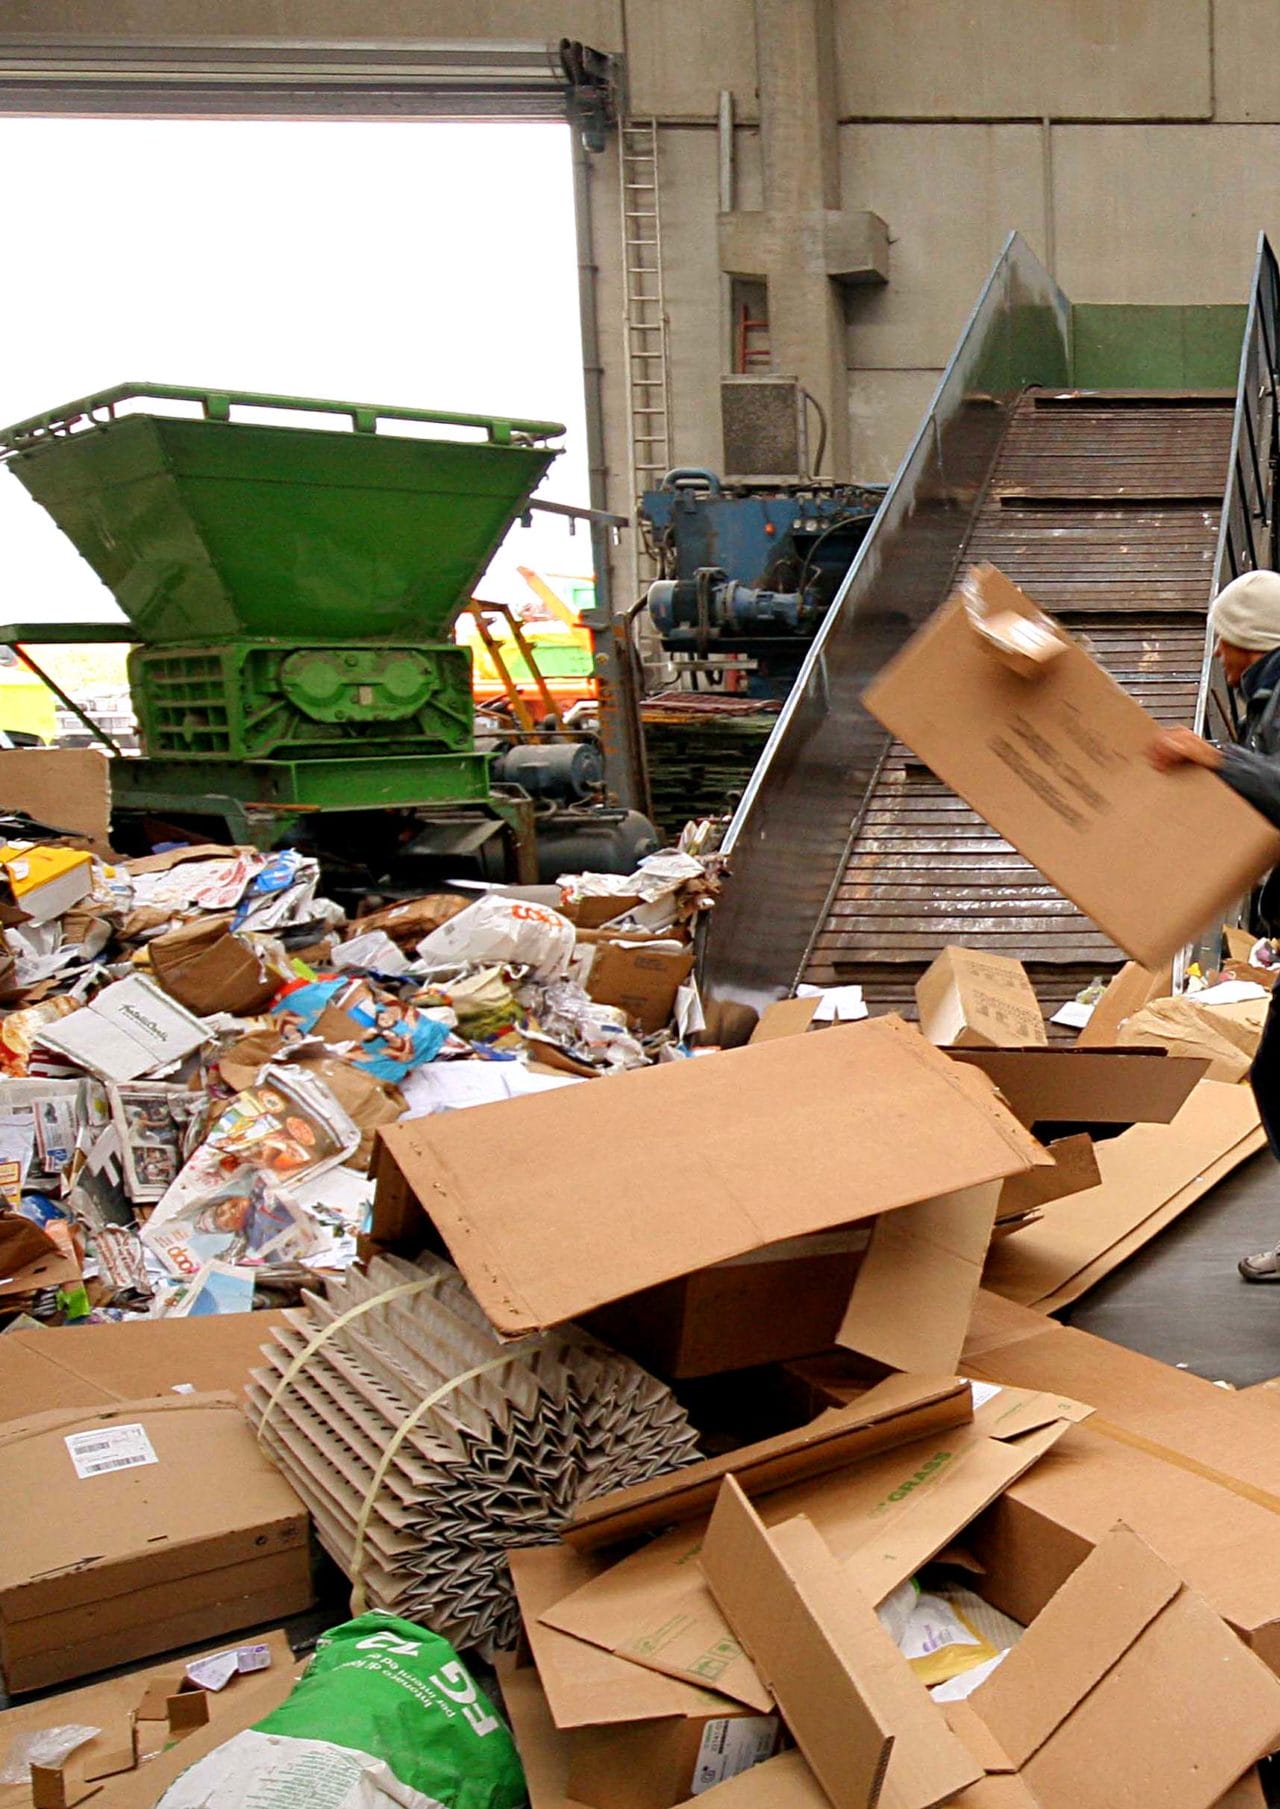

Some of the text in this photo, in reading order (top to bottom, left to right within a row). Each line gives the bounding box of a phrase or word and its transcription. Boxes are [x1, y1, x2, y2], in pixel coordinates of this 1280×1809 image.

[379, 1657, 399, 1670] ed
[382, 1669, 433, 1708] Intonaco
[397, 1669, 437, 1699] interni
[428, 1660, 499, 1737] FG
[436, 1699, 457, 1718] per
